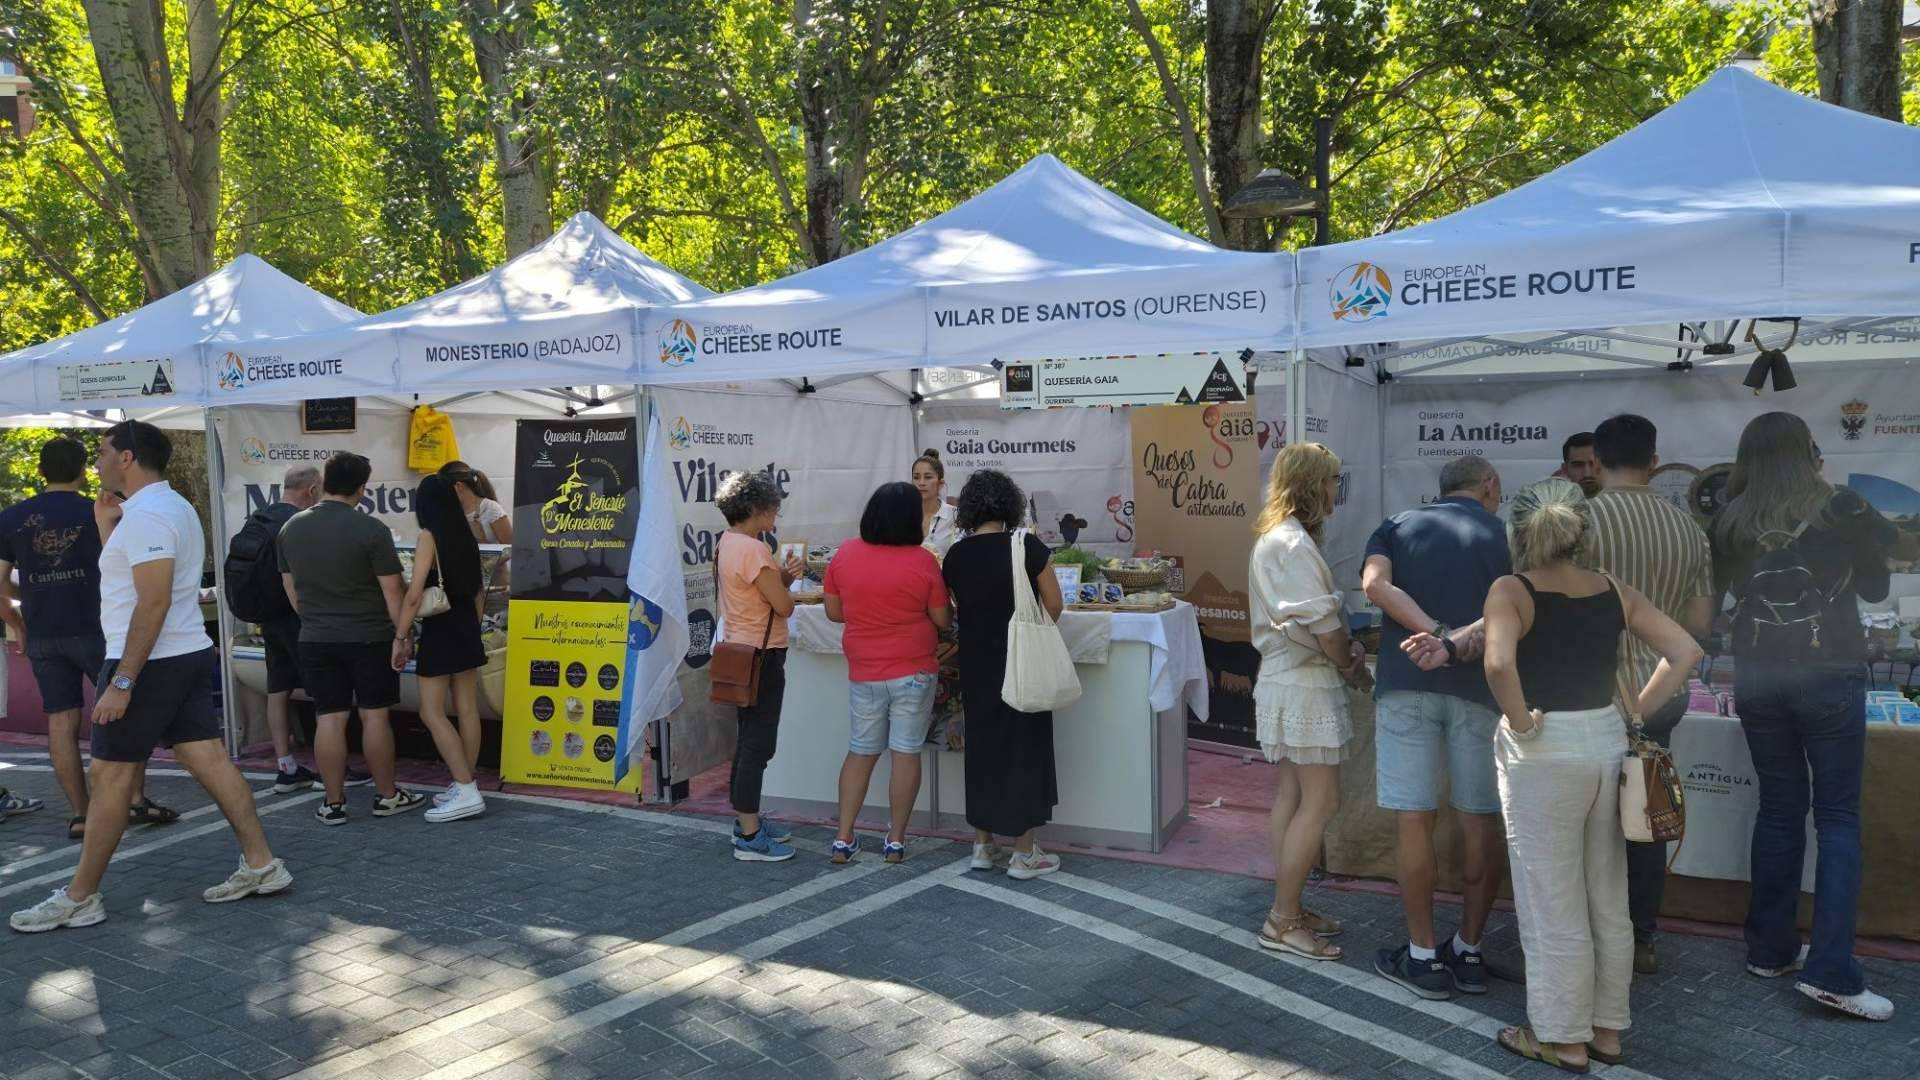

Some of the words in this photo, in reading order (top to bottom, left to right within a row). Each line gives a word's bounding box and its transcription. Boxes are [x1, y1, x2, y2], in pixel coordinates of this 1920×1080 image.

[1404, 263, 1486, 282] EUROPEAN
[1401, 275, 1516, 306] CHEESE
[1528, 265, 1635, 297] ROUTE
[935, 307, 995, 328] VILAR
[1002, 305, 1029, 325] DE
[1036, 299, 1126, 321] SANTOS
[1134, 289, 1266, 320] (OURENSE)
[703, 324, 753, 336] EUROPEAN
[426, 342, 528, 362] MONESTERIO
[534, 333, 621, 360] (BADAJOZ)
[702, 333, 771, 355] CHEESE
[778, 328, 842, 350] ROUTE
[248, 355, 282, 366] EUROPEAN
[248, 363, 296, 381] CHEESE
[300, 359, 342, 377] ROUTE
[1044, 375, 1092, 386] QUESERÍA
[1095, 375, 1119, 384] GAIA
[692, 432, 725, 445] CHEESE
[728, 433, 754, 446] ROUTE
[1418, 424, 1444, 442] La
[1450, 422, 1548, 445] Antigua
[268, 449, 310, 461] CHEESE
[313, 450, 336, 461] ROU
[946, 439, 984, 455] Gaia
[988, 438, 1076, 454] Gourmets
[1143, 442, 1196, 476] Quesos
[1171, 470, 1228, 508] Cabra
[1186, 500, 1247, 517] artesanales
[1687, 771, 1752, 786] ANTIGUA
